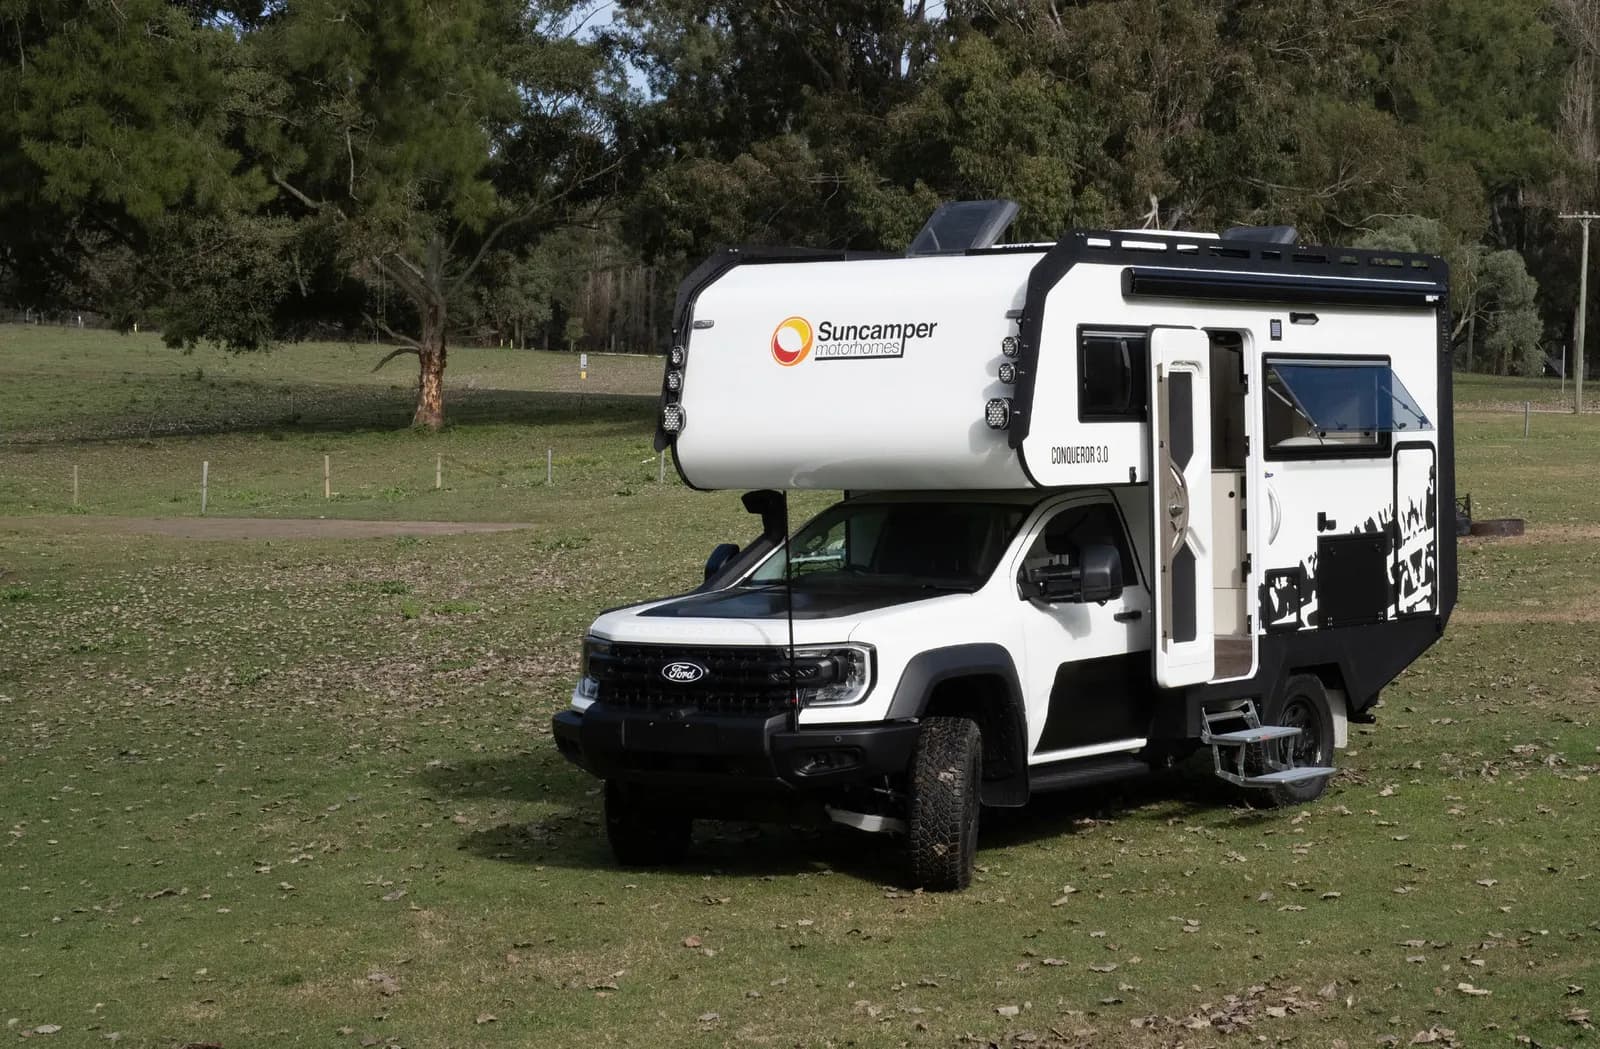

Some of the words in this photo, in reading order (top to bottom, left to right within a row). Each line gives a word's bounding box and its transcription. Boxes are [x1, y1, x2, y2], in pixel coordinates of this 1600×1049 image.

[818, 321, 937, 346] Suncamper
[815, 341, 900, 356] motorhomes
[1051, 446, 1095, 465] CONQUEROR
[1096, 445, 1109, 463] 3.0
[668, 664, 696, 679] Ford
